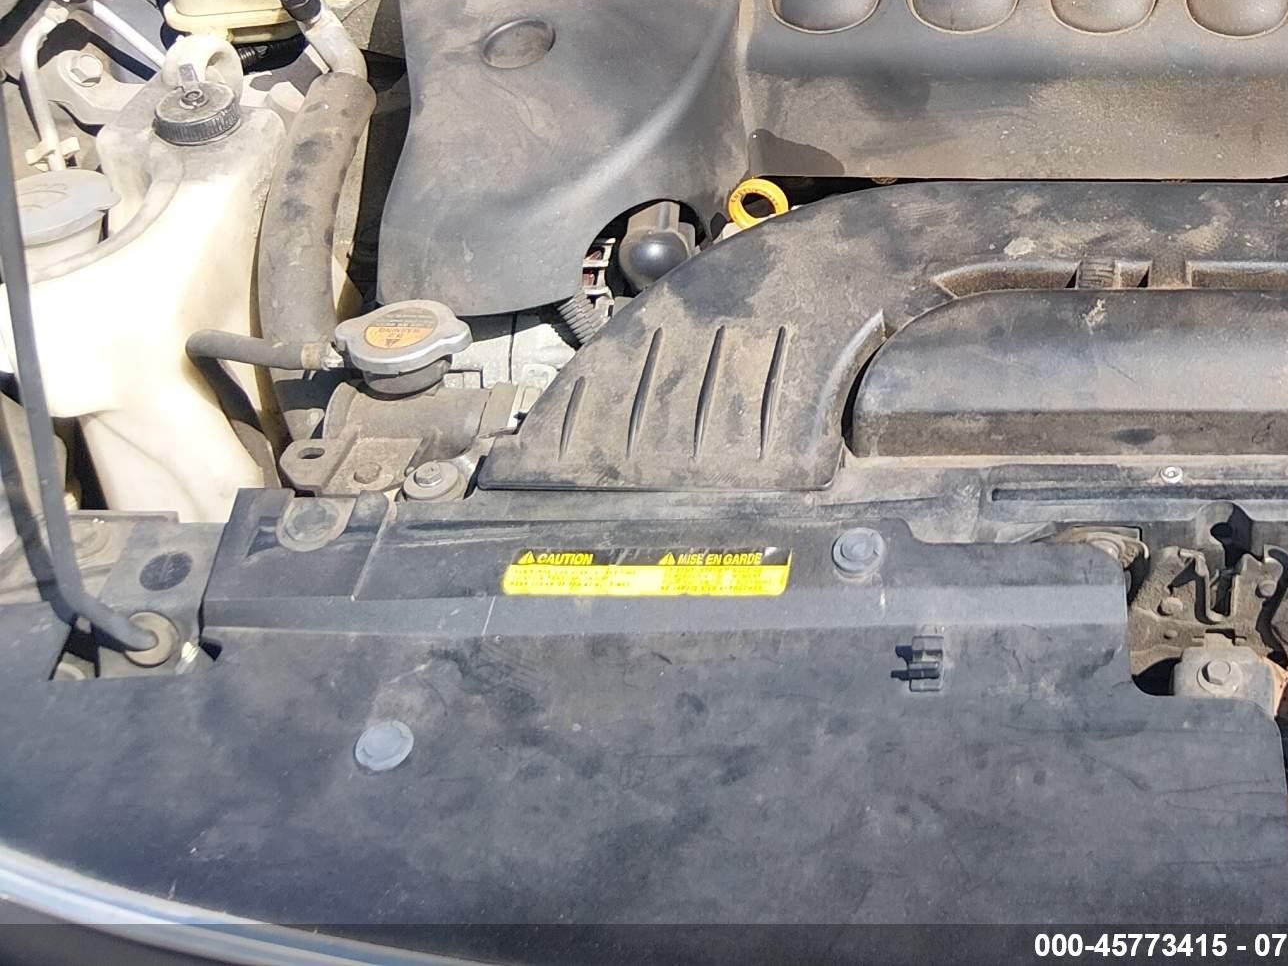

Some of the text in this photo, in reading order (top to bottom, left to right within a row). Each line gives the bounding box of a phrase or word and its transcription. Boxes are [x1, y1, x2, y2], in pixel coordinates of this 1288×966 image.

[537, 553, 594, 565] CAUTION
[677, 552, 762, 565] MISE EN GARDE
